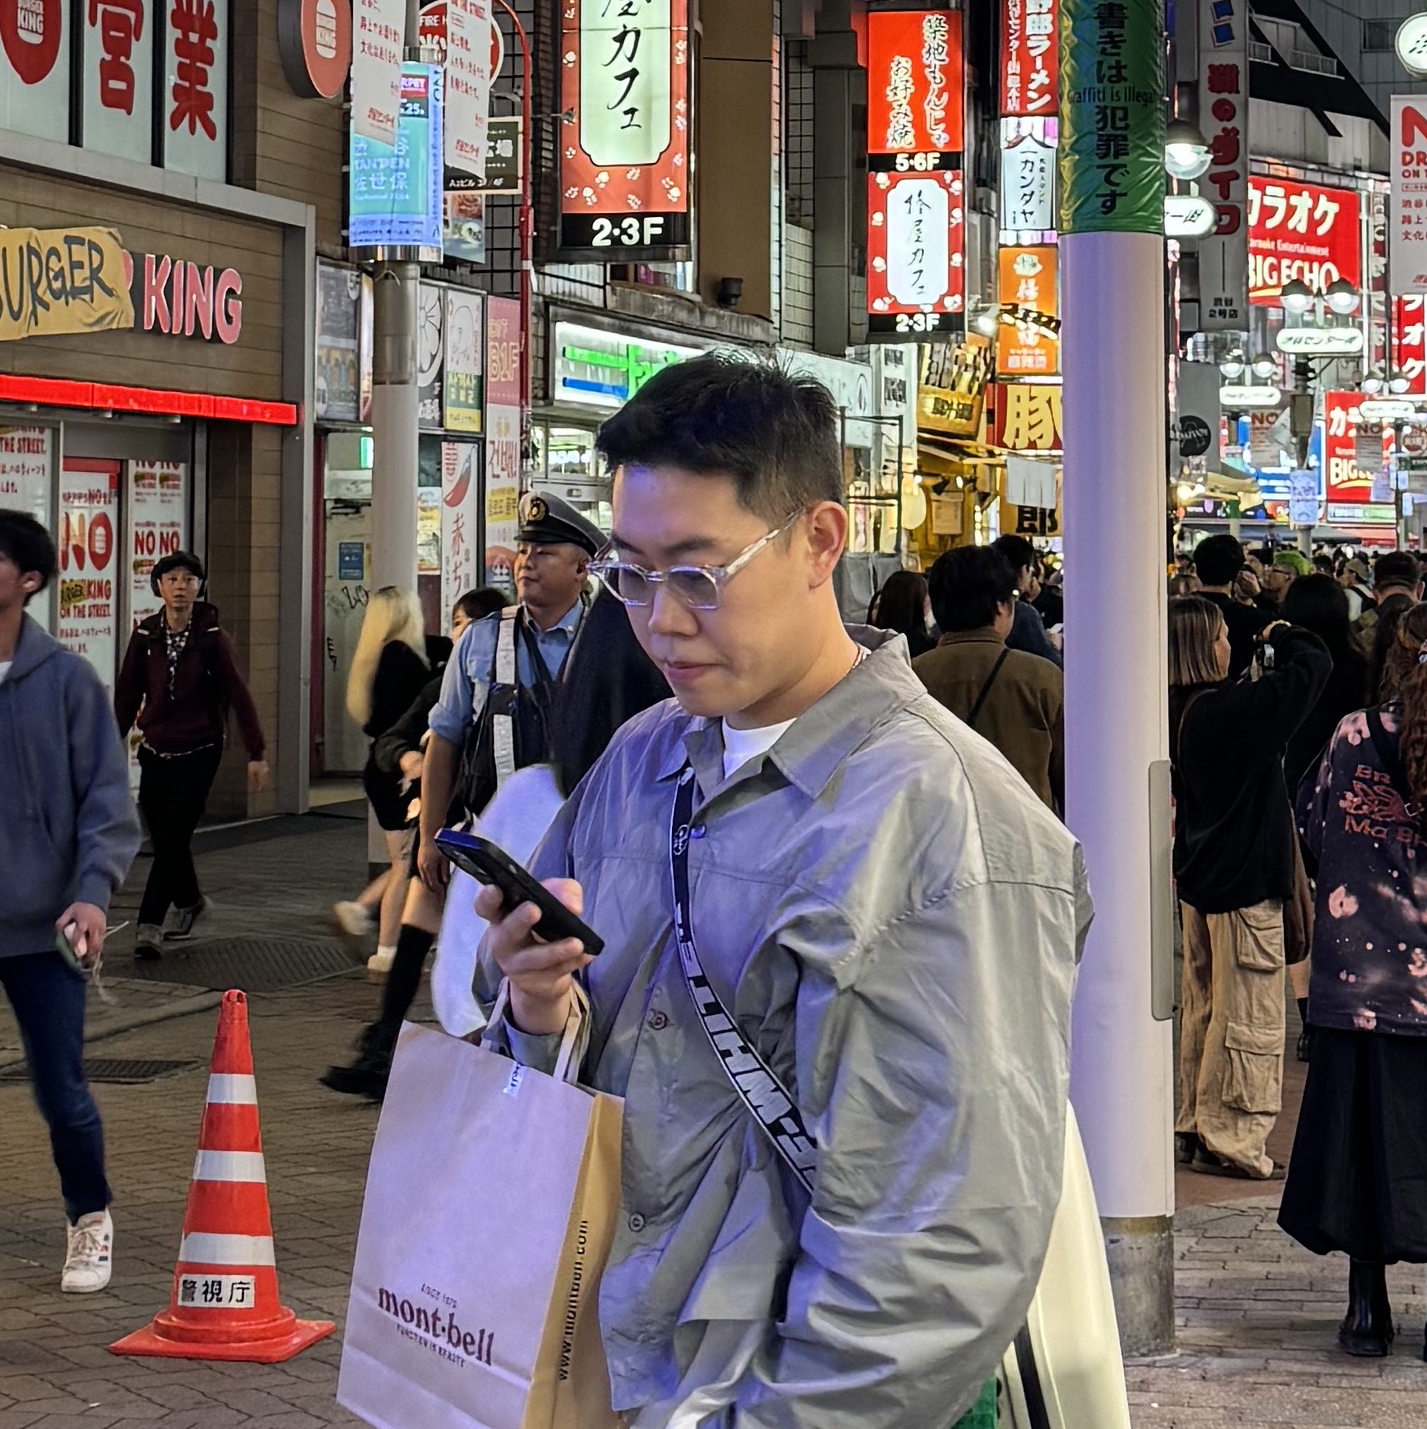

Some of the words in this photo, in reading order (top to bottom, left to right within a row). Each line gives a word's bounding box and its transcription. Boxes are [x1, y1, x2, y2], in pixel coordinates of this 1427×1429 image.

[1401, 168, 1420, 179] ON
[1248, 182, 1340, 237] カラオケ
[143, 251, 244, 345] KING
[1003, 384, 1062, 450] 豚
[181, 1278, 253, 1306] 警視庁
